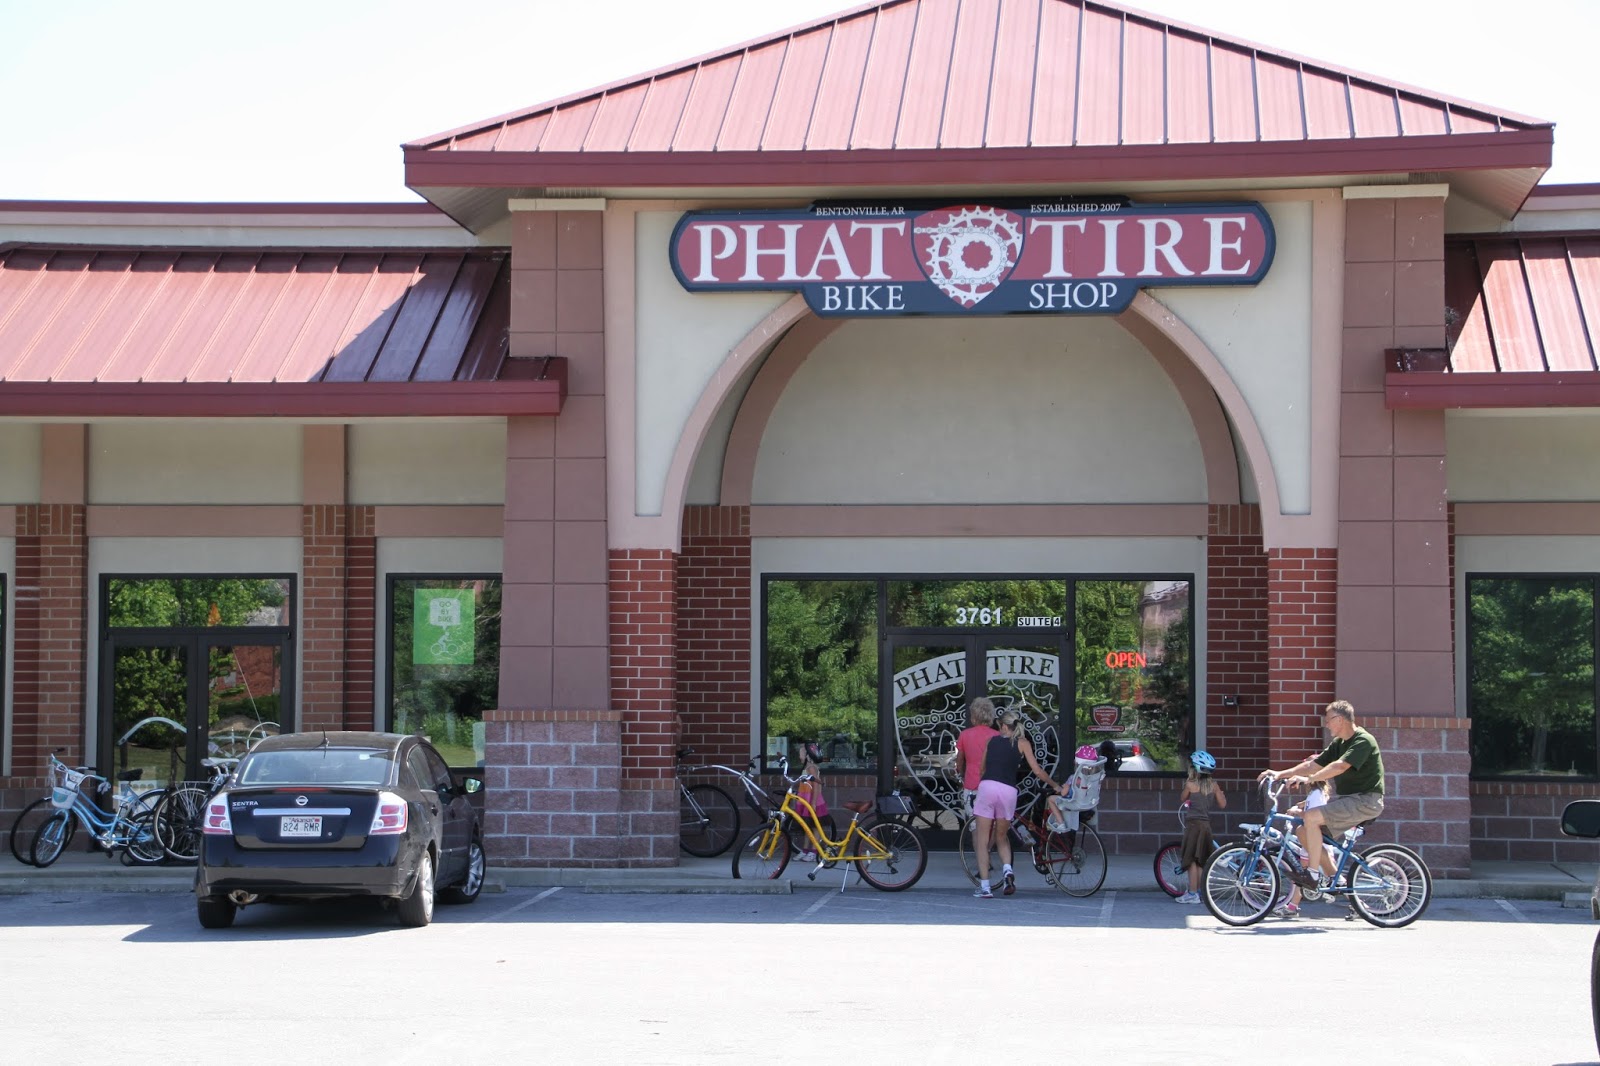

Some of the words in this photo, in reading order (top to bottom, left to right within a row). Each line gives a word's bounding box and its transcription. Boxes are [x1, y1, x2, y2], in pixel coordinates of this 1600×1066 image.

[816, 206, 889, 216] BENTONVILLE,
[891, 206, 906, 215] AR
[1030, 204, 1099, 213] ESTABLISHED
[1100, 203, 1121, 212] 2007
[693, 221, 906, 281] PHAT
[1030, 217, 1250, 278] TIRE
[822, 285, 906, 311] BIKE
[1029, 282, 1117, 309] SHOP
[955, 607, 1002, 625] 3761
[1018, 617, 1051, 626] SUITE
[1053, 617, 1060, 626] 4
[1105, 651, 1147, 668] OPEN
[895, 658, 966, 698] PHAT
[986, 655, 1055, 678] TIRE
[283, 823, 299, 832] 824
[304, 823, 320, 832] RMR
